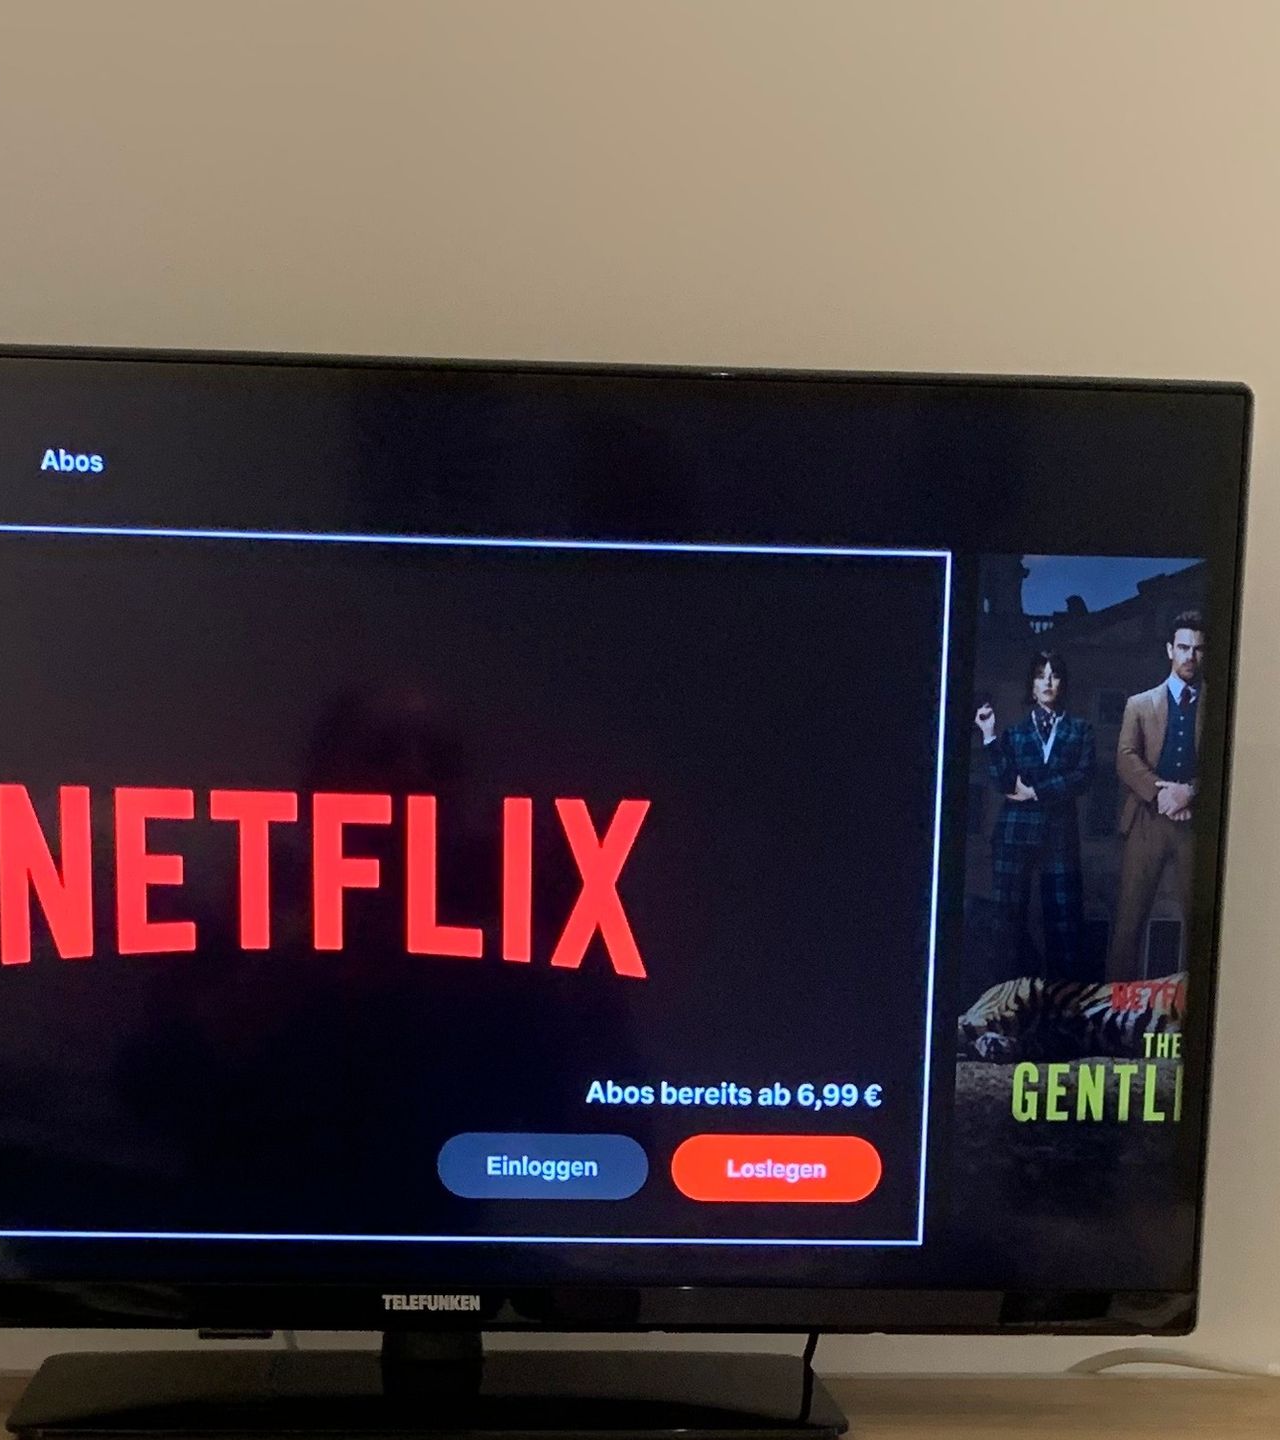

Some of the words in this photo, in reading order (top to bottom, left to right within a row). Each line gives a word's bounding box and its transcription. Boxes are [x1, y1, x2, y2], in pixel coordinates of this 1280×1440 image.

[40, 449, 104, 472] Abos
[1143, 1032, 1182, 1058] THE
[585, 1080, 655, 1105] Abos
[660, 1081, 752, 1107] bereits
[757, 1083, 790, 1107] ab
[796, 1083, 859, 1111] 6,99
[863, 1084, 882, 1107] €
[486, 1156, 599, 1182] Einloggen
[726, 1159, 827, 1184] Loslegen
[381, 1294, 480, 1311] TELEFUNKEN
